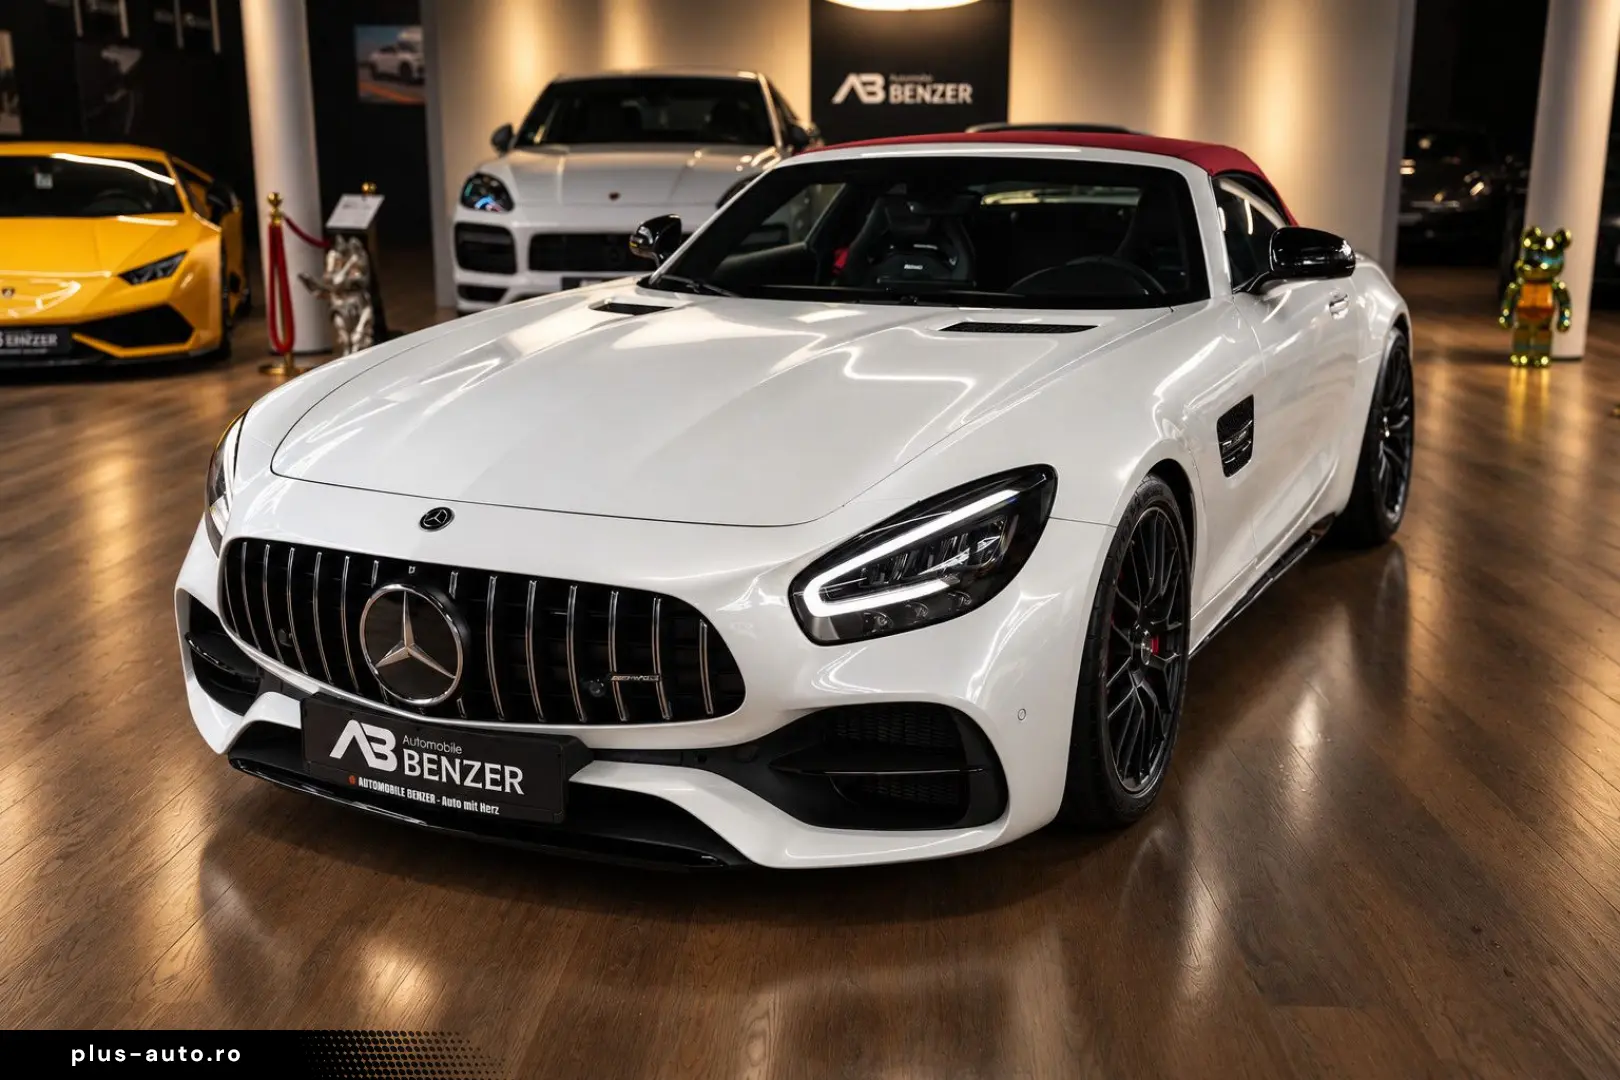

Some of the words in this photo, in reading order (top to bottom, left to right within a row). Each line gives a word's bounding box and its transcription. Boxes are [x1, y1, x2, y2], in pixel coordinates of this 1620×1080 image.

[889, 83, 973, 104] BENZER
[402, 734, 463, 755] Automobile
[402, 748, 525, 795] BENZER
[358, 776, 406, 797] AUTOMOBILE
[406, 788, 436, 805] BENZER
[441, 795, 462, 809] Auto
[463, 799, 478, 812] mit
[480, 802, 500, 815] Herz
